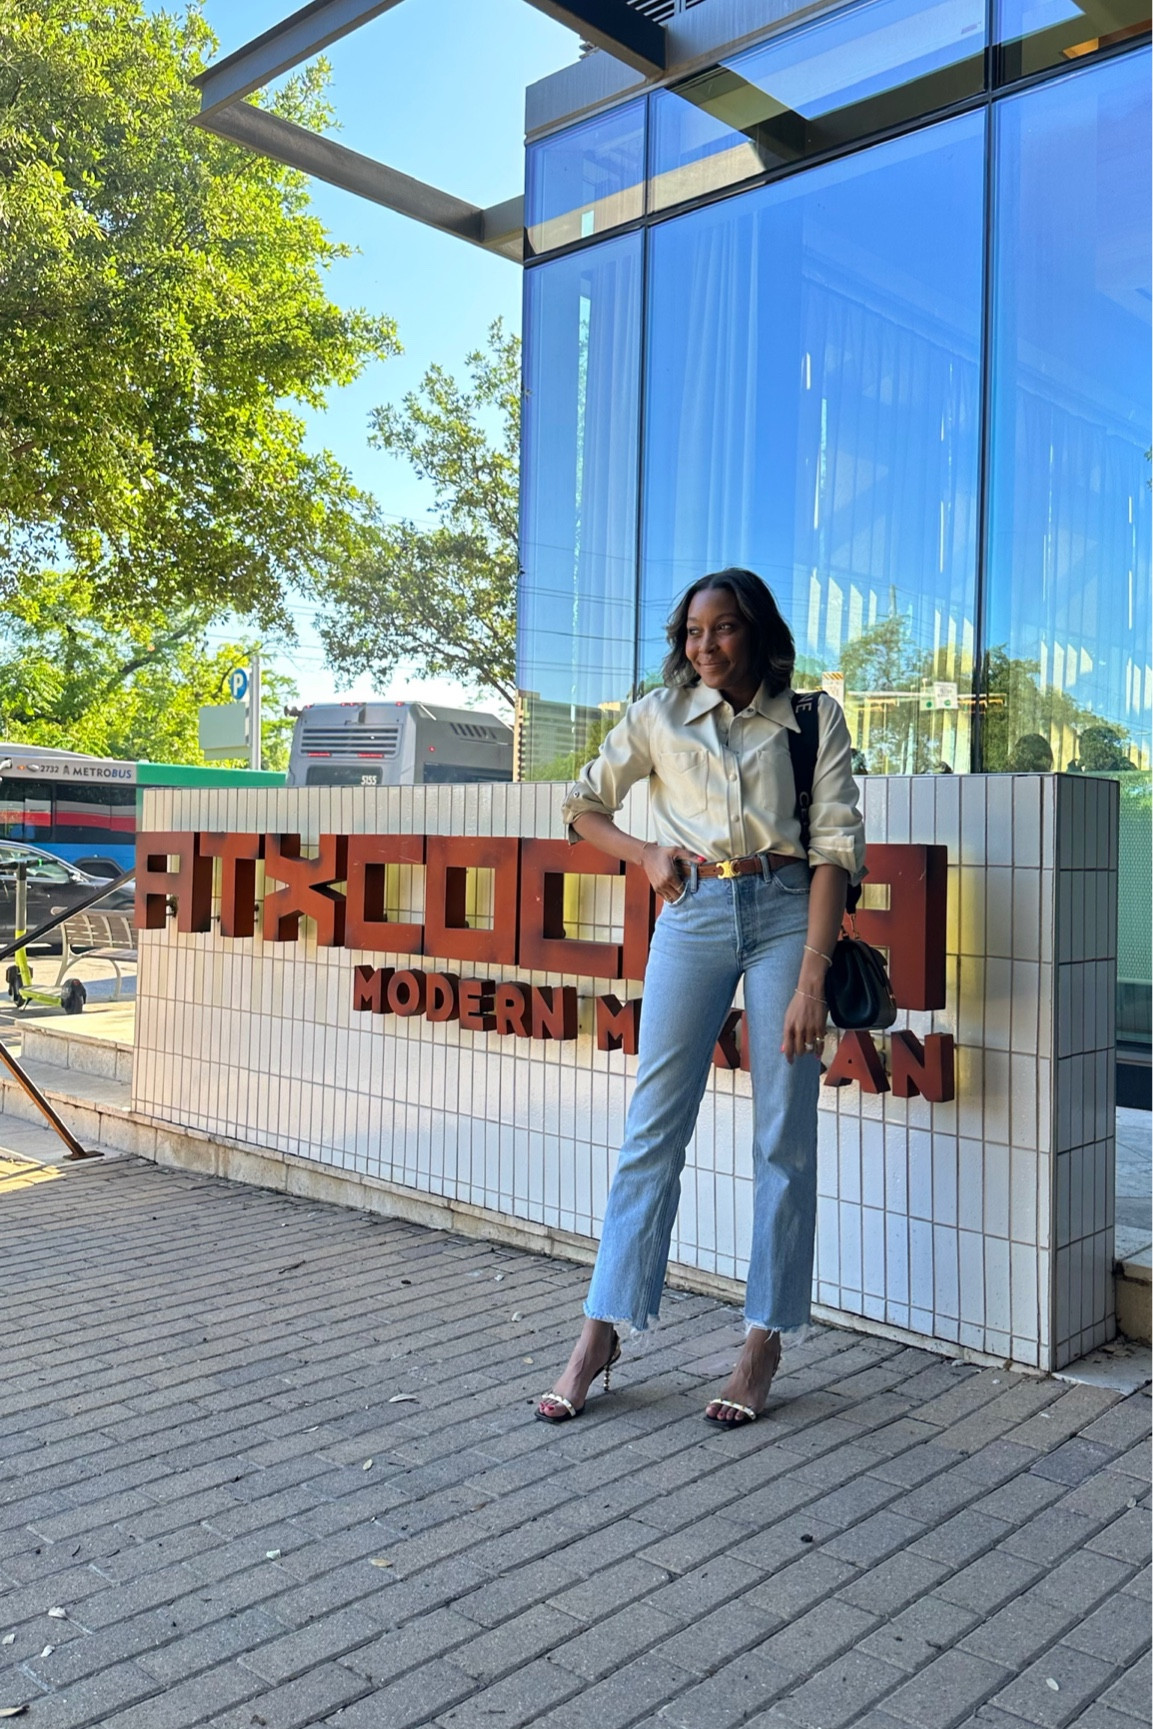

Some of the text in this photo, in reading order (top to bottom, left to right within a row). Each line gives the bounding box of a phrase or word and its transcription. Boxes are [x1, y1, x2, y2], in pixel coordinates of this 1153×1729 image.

[233, 673, 244, 696] P
[40, 765, 59, 773] 2732
[72, 768, 132, 779] METROBUS
[353, 964, 577, 1040] MODERN
